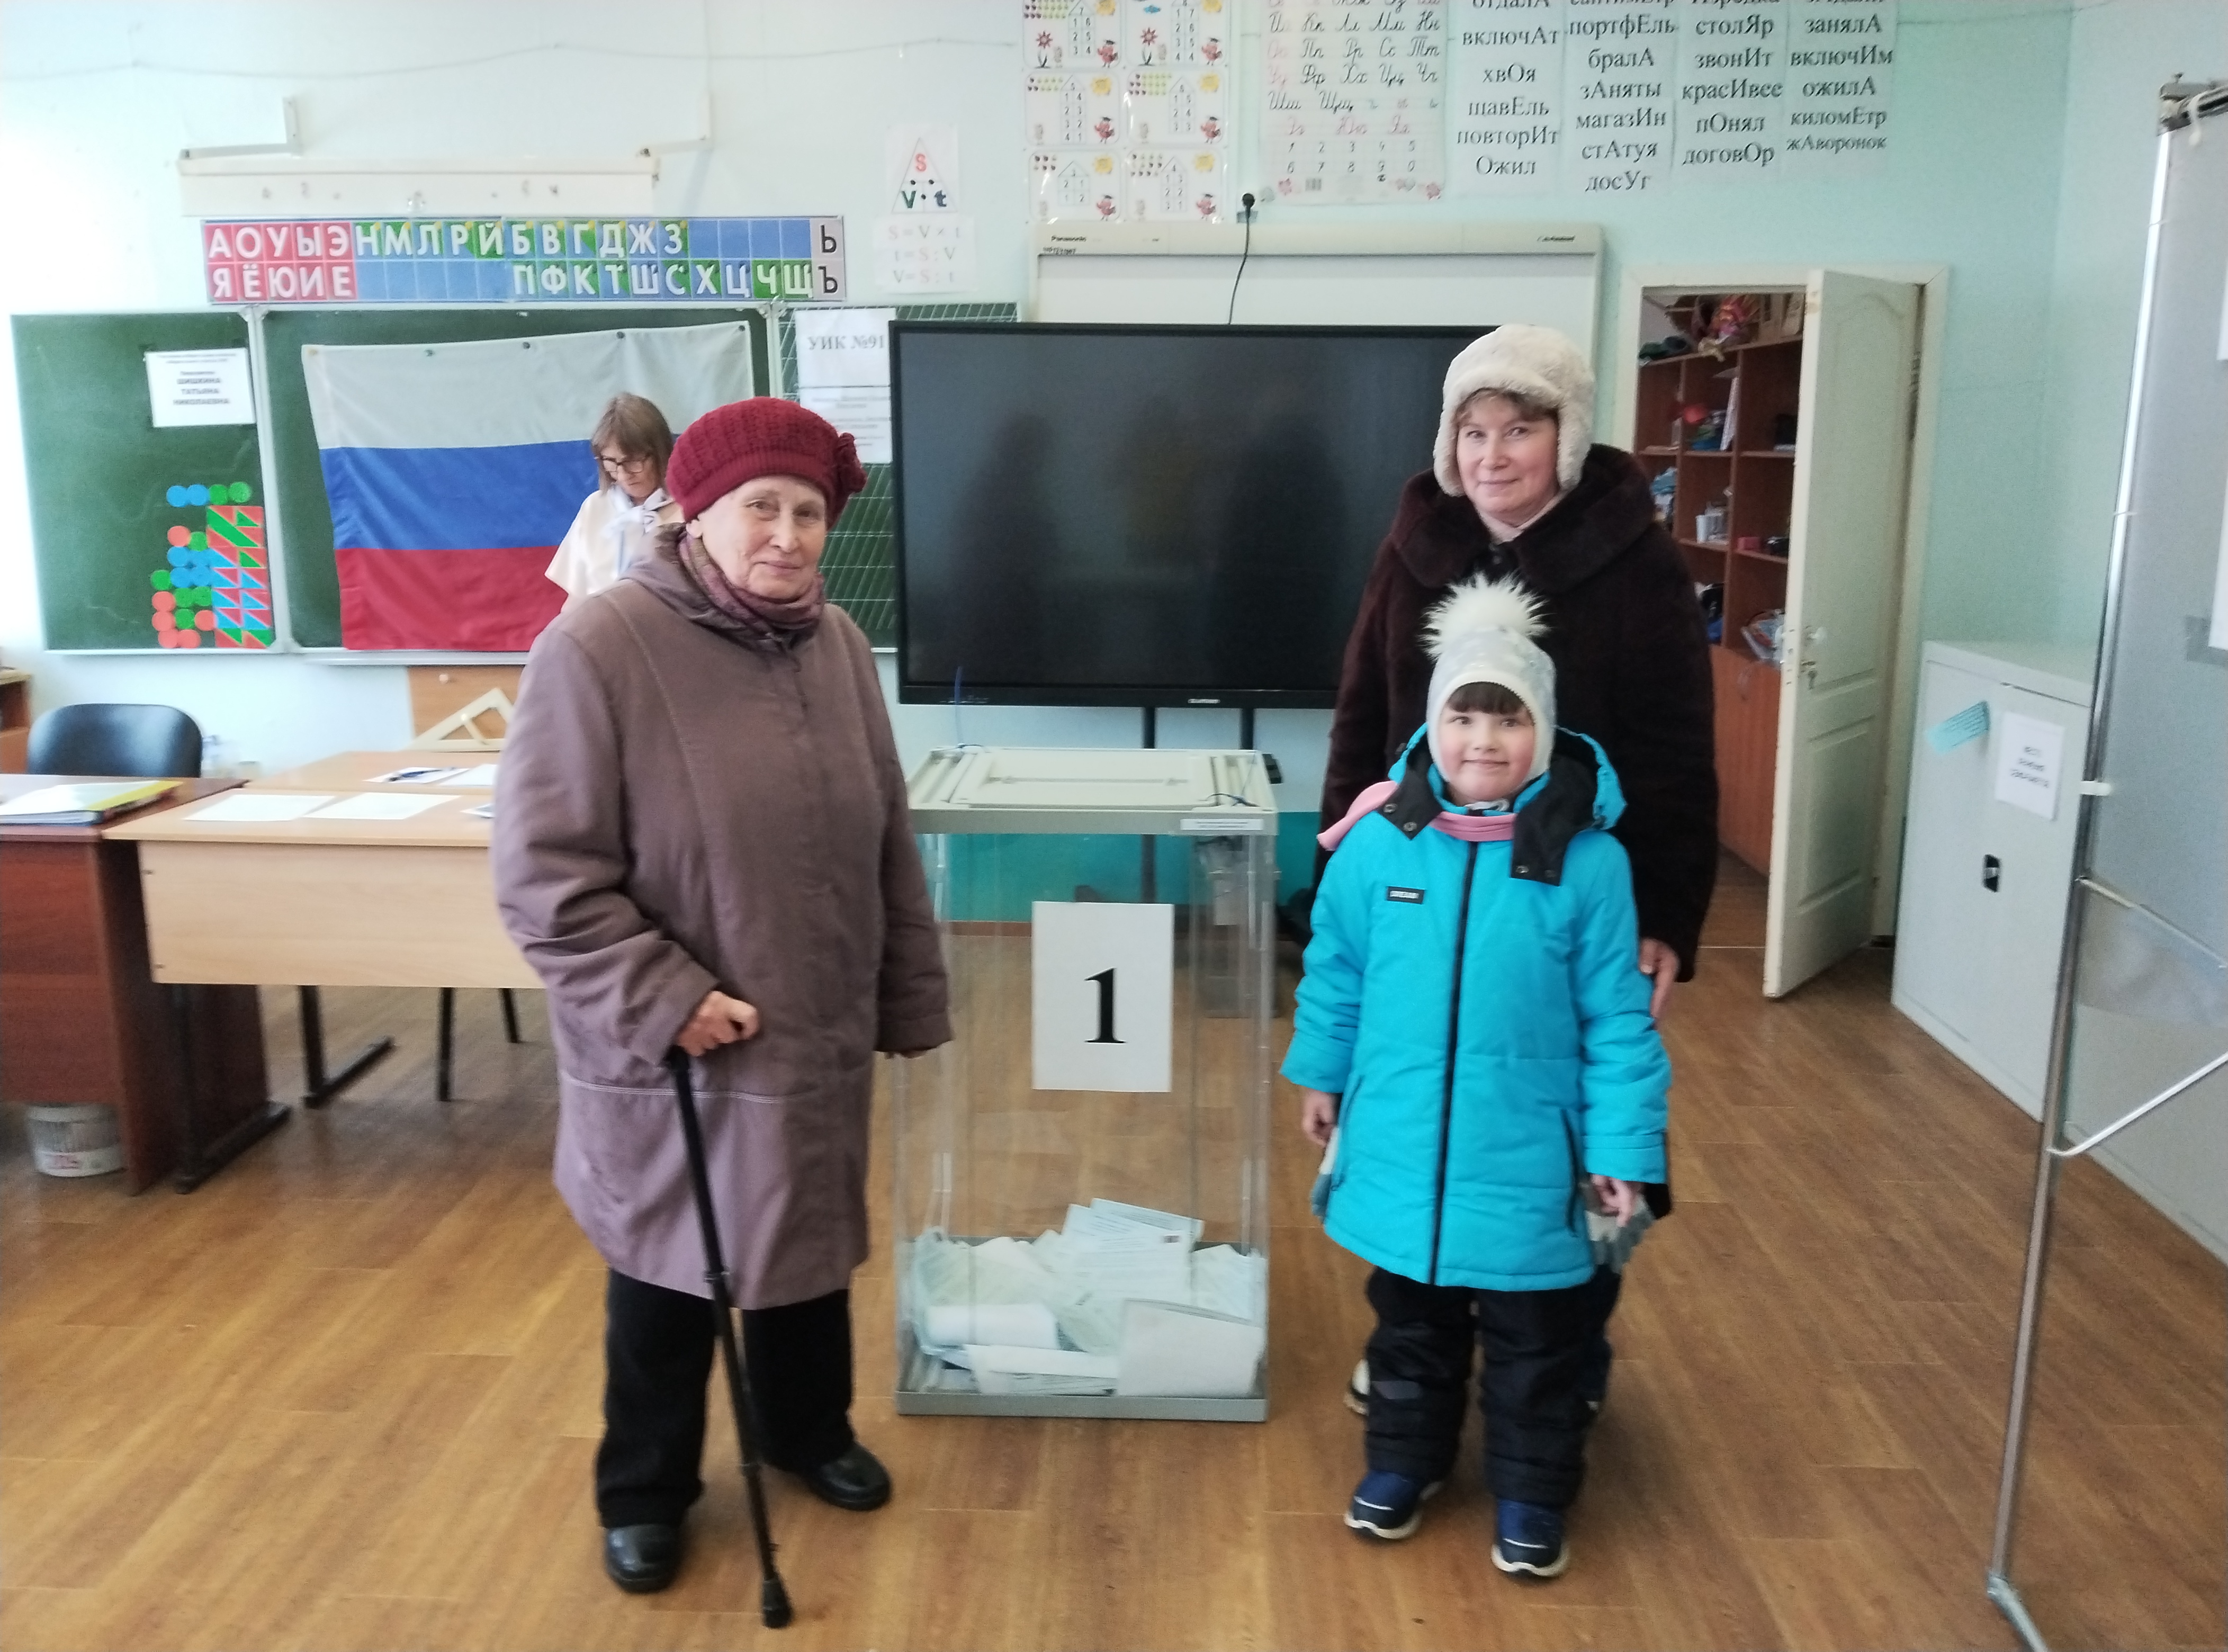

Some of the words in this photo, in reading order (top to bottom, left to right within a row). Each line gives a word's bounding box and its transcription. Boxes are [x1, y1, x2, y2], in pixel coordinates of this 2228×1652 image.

[1073, 18, 1076, 26] 1
[1177, 8, 1180, 18] 1
[1176, 23, 1180, 32] 2
[1569, 13, 1676, 40] портфЕль
[1695, 14, 1775, 39] столЯр
[1804, 14, 1883, 34] занялА
[1073, 32, 1078, 41] 2
[1462, 25, 1561, 46] включАт
[1588, 48, 1655, 73] бралА
[1695, 47, 1774, 69] звонИт
[1789, 44, 1895, 67] включИм
[1483, 62, 1537, 83] хвОя
[1580, 79, 1662, 100] зАняты
[1681, 78, 1784, 105] красИвее
[1802, 75, 1877, 97] ожилА
[1065, 92, 1068, 102] 1
[1174, 95, 1178, 103] 1
[1065, 106, 1069, 115] 2
[1173, 109, 1178, 117] 2
[1575, 107, 1667, 129] магазИн
[1790, 106, 1889, 130] киломЕтр
[1077, 119, 1082, 128] 2
[1695, 112, 1766, 133] пОнял
[1078, 132, 1082, 142] 1
[1318, 141, 1325, 154] 2
[1457, 125, 1561, 150] повторИт
[1785, 134, 1888, 155] жАворонок
[1581, 139, 1659, 163] стАтуя
[1682, 141, 1775, 168] договОр
[915, 154, 927, 172] S
[1287, 161, 1295, 174] 6
[1476, 155, 1537, 176] Ожил
[1584, 170, 1652, 193] досУг
[808, 335, 846, 350] УИК
[850, 334, 885, 349] №91
[1084, 967, 1127, 1044] 1
